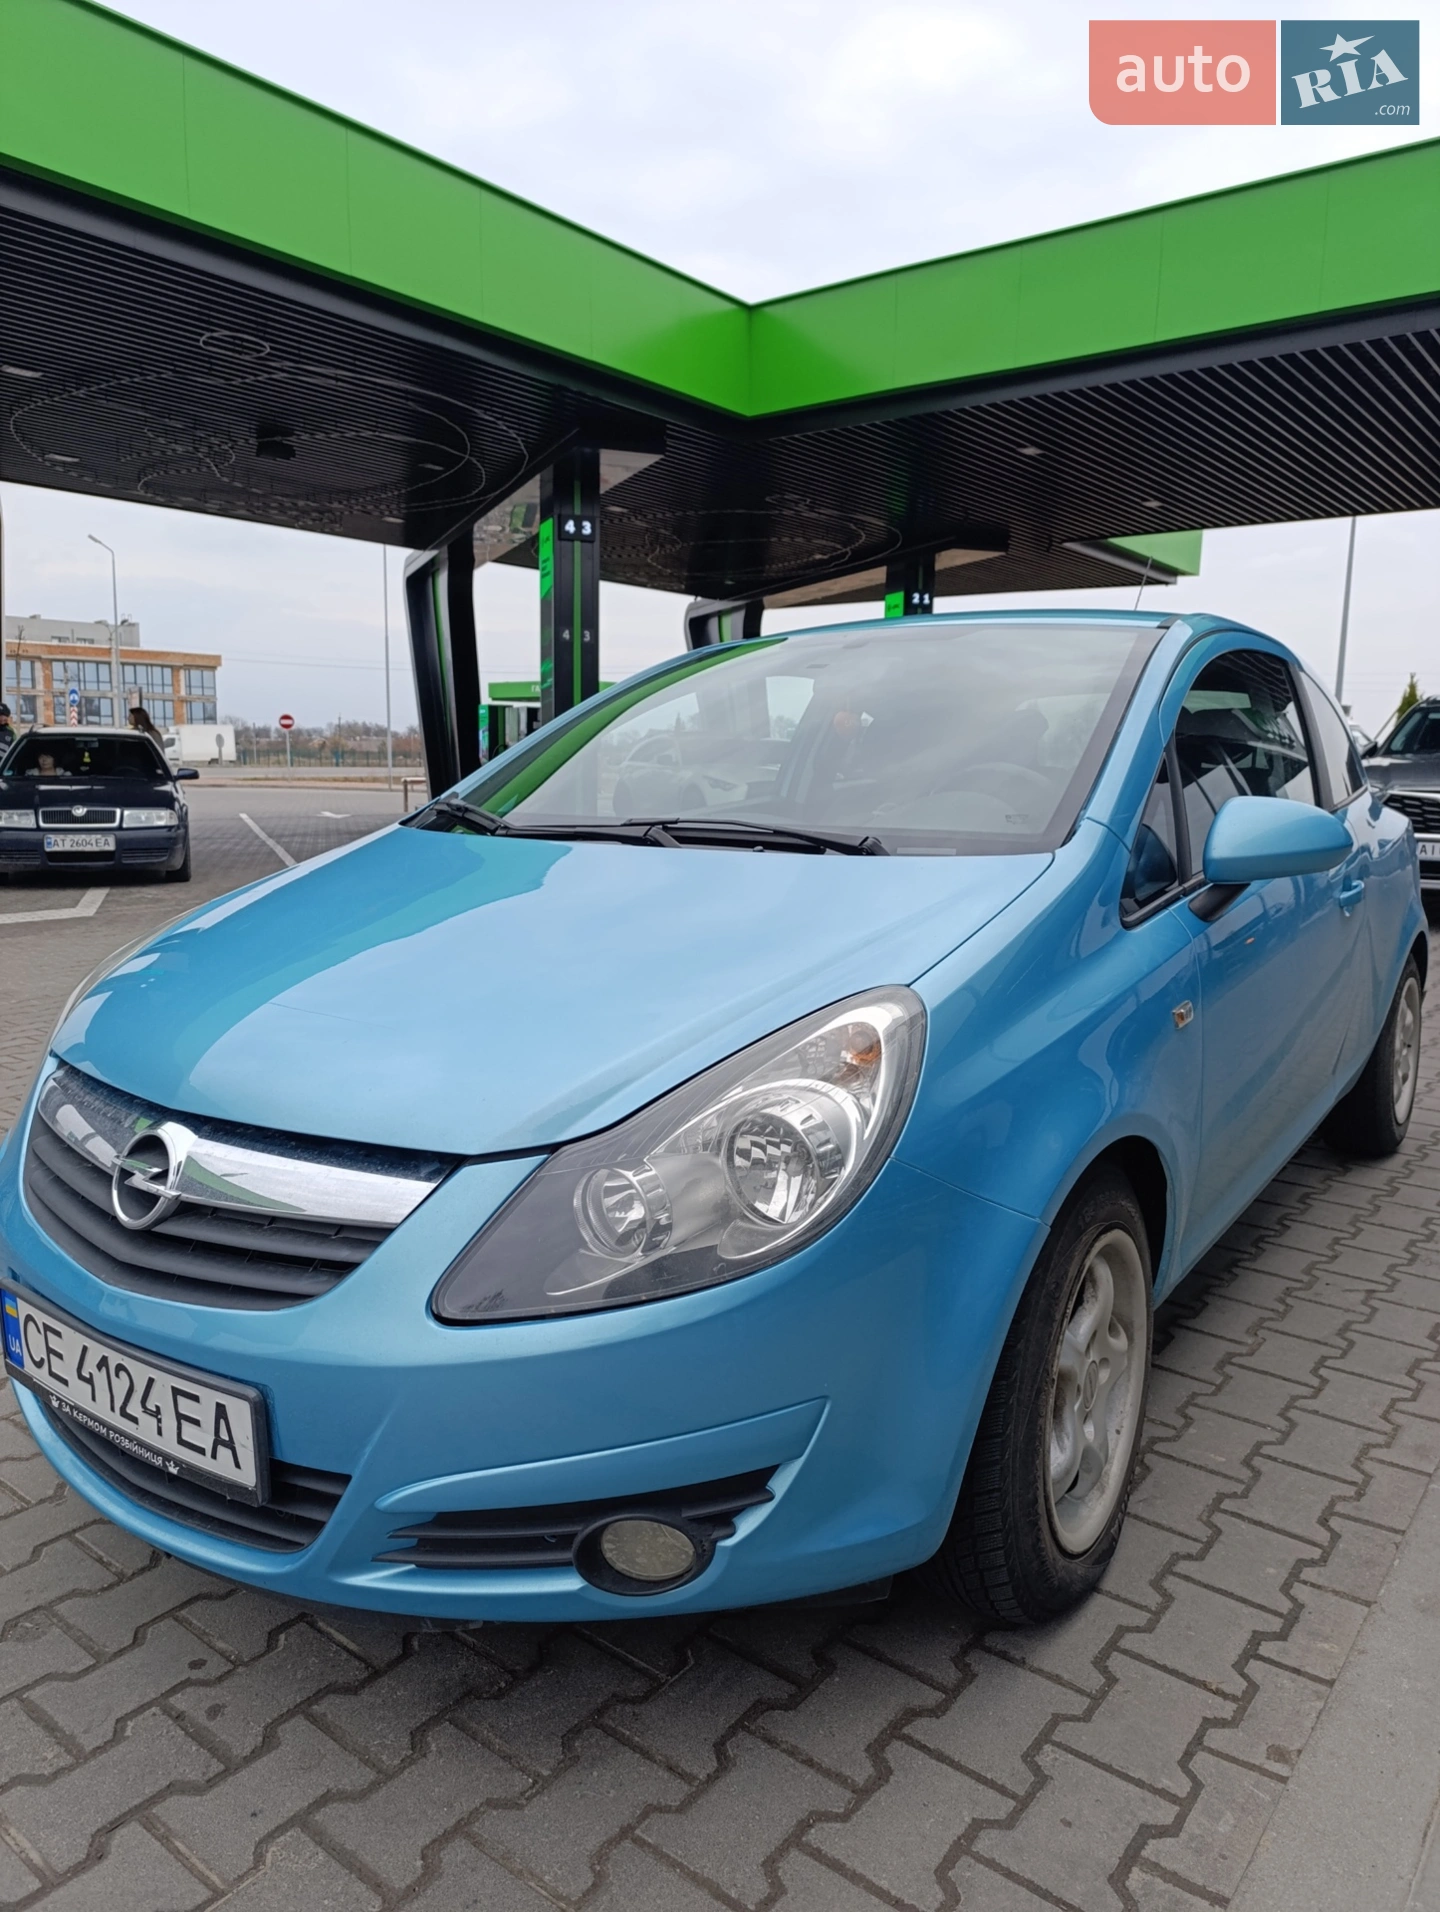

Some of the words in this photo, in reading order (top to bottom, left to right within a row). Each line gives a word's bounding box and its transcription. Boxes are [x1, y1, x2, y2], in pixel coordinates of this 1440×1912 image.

[564, 519, 576, 534] 4
[581, 520, 592, 536] 3
[912, 592, 920, 604] 2
[69, 838, 93, 848] 2604
[8, 1334, 22, 1356] UA
[23, 1313, 69, 1387] CE
[76, 1344, 163, 1437] 4124
[171, 1385, 242, 1470] EA
[61, 1402, 72, 1416] ЗА
[72, 1408, 107, 1437] КЕРМОМ
[108, 1430, 163, 1467] РОЗБІЙНИЦЯ
